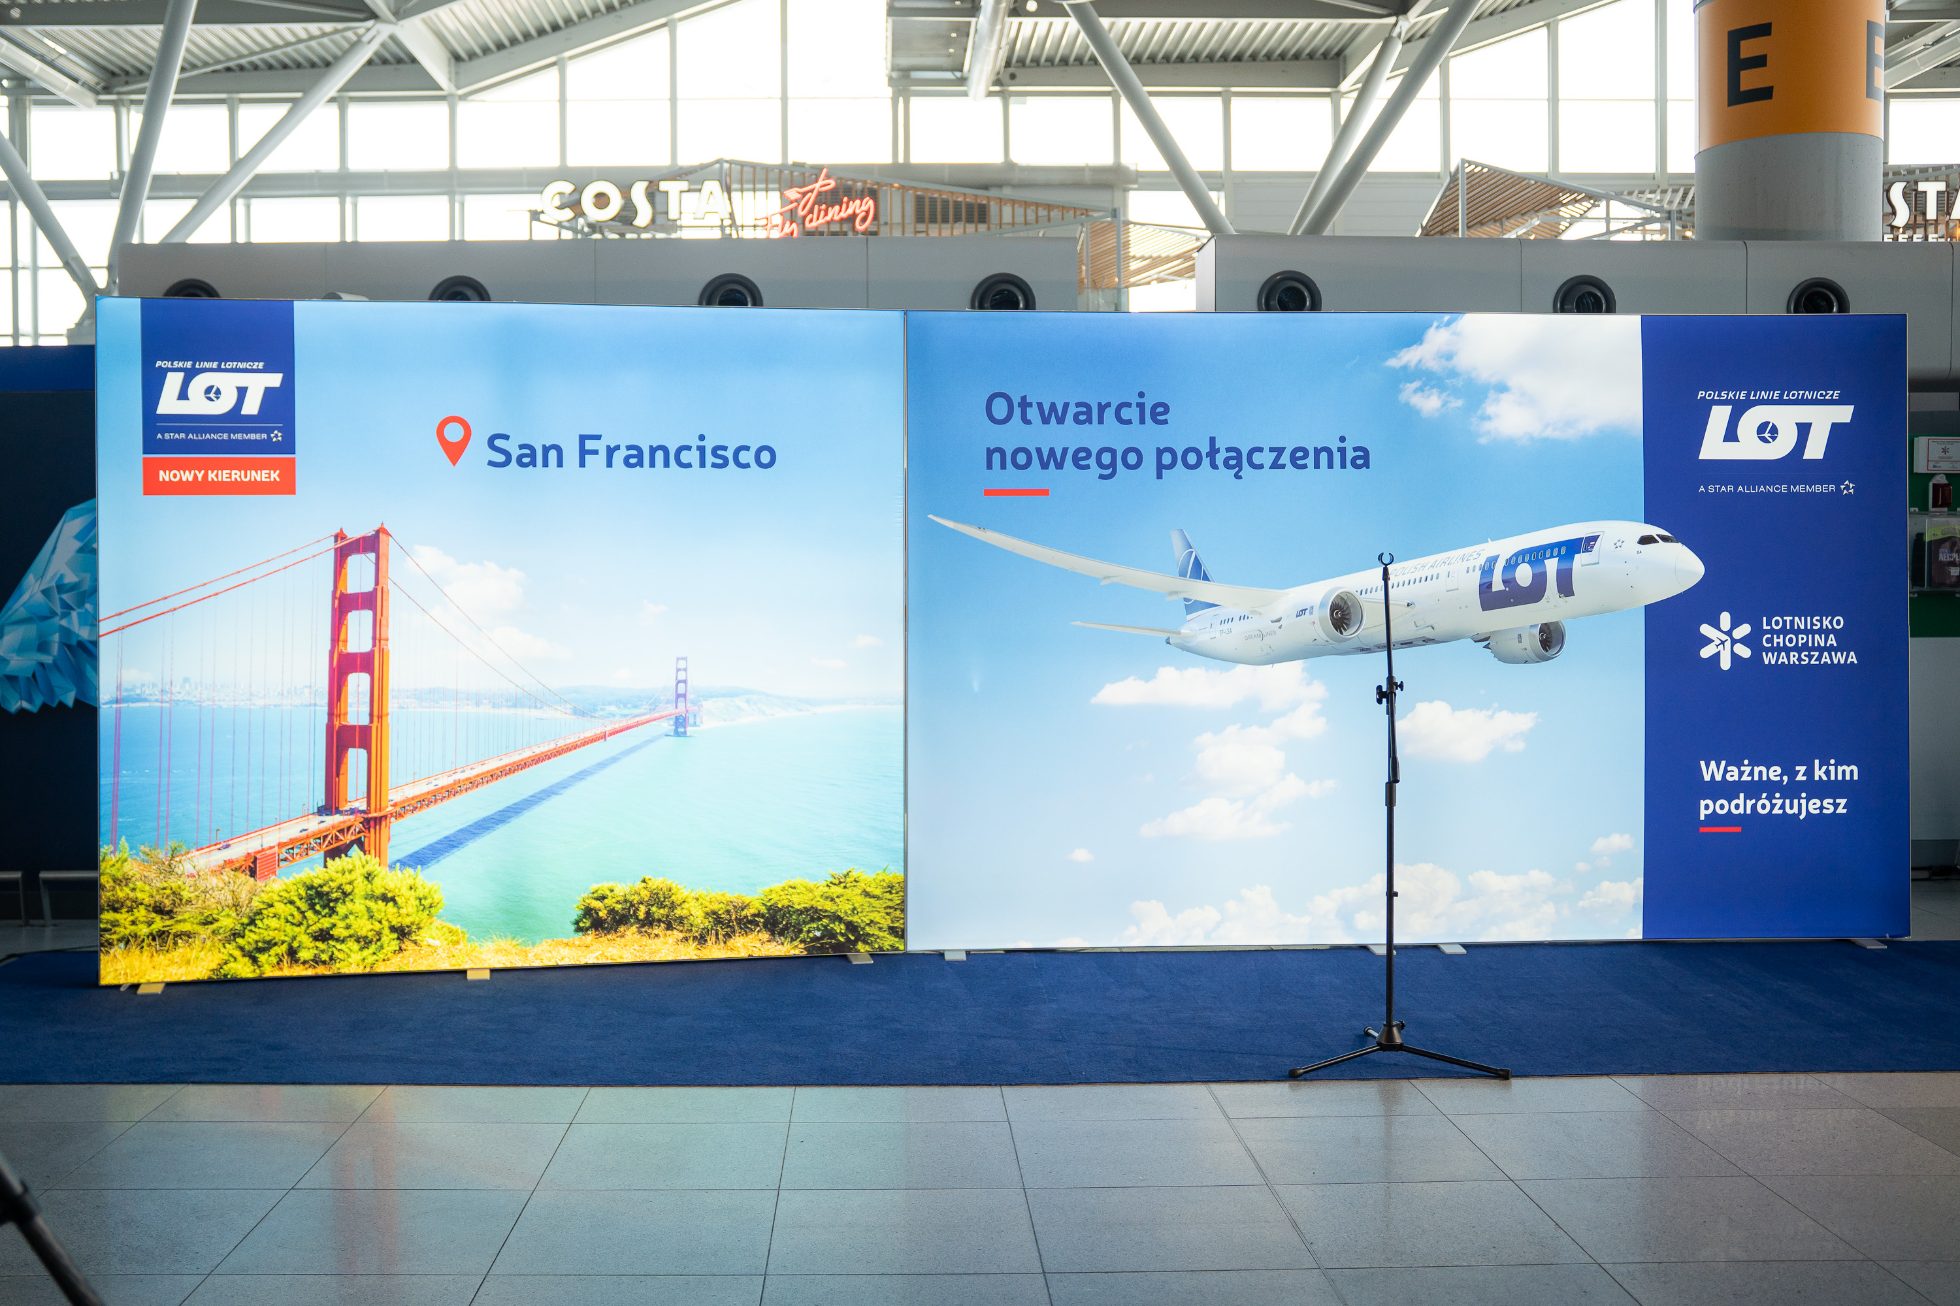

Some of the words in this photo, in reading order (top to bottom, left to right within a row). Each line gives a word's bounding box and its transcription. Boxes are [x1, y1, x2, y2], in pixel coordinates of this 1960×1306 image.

[1726, 20, 1775, 108] E
[541, 180, 731, 228] COSTA
[805, 196, 875, 232] dining
[155, 360, 193, 369] POLSKIE
[195, 361, 219, 369] LINIE
[220, 361, 265, 370] LOTNICZE
[156, 371, 284, 415] LOT
[1697, 390, 1748, 400] POLSKIE
[1749, 390, 1781, 400] LINIE
[1783, 390, 1841, 400] LOTNICZE
[985, 391, 1171, 426] Otwarcie
[156, 432, 163, 440] A
[164, 432, 186, 440] STAR
[187, 432, 229, 440] ALLIANCE
[230, 432, 268, 440] MEMBER
[1698, 405, 1855, 460] LOT
[487, 433, 564, 469] San
[578, 434, 777, 470] Francisco
[985, 446, 1144, 480] nowego
[1155, 436, 1371, 480] połączenia
[159, 469, 205, 482] NOWY
[207, 469, 280, 482] KIERUNEK
[1698, 485, 1706, 493] A
[1708, 484, 1734, 493] STAR
[1736, 484, 1788, 493] ALLIANCE
[1790, 484, 1836, 493] MEMBER
[1479, 535, 1600, 612] LOT
[1762, 615, 1844, 630] LOTNISKO
[1762, 633, 1837, 648] CHOPINA
[1762, 651, 1858, 665] WARSZAWA
[1699, 760, 1789, 785] Ważne,
[1795, 766, 1807, 781] z
[1814, 758, 1859, 781] kim
[1699, 792, 1848, 822] podróżujesz
